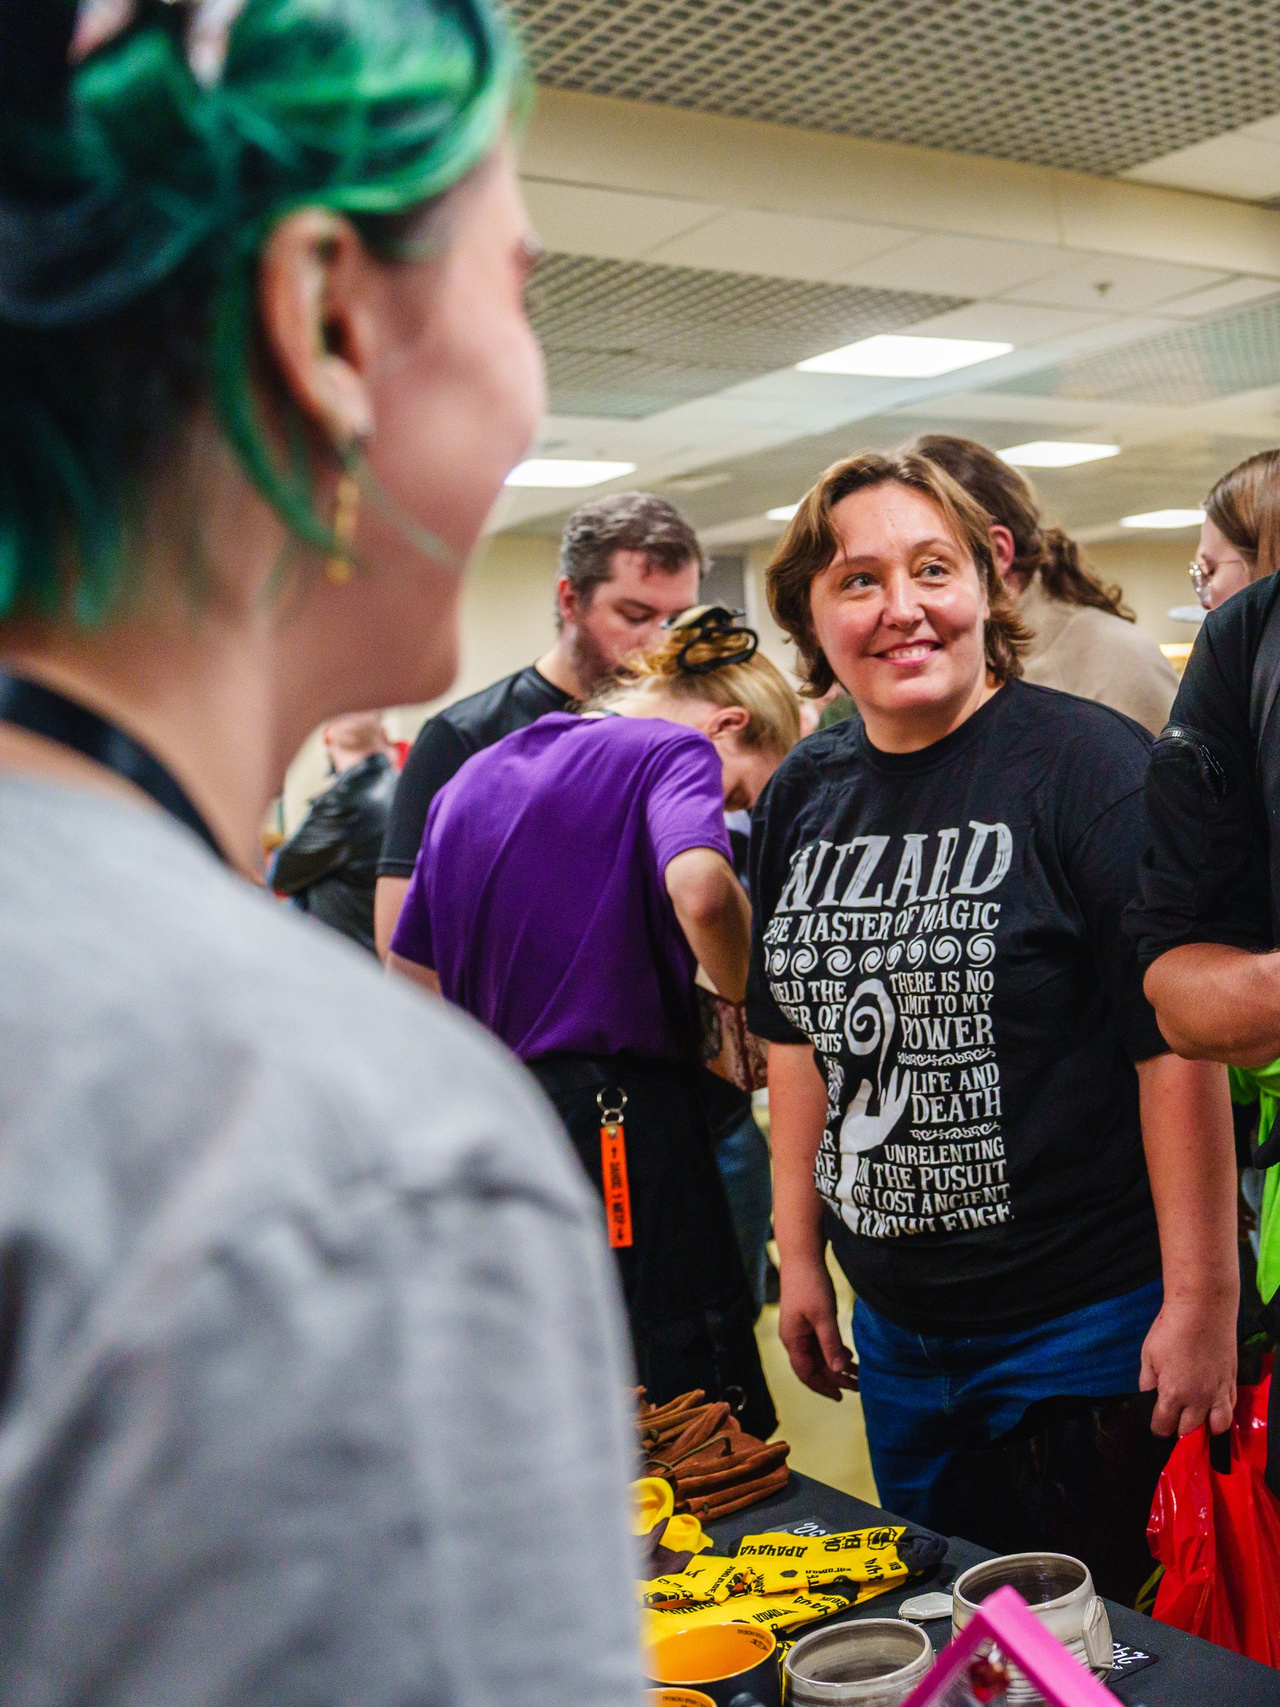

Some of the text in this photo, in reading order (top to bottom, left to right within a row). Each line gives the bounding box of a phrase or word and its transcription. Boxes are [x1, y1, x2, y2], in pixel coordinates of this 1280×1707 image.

[793, 911, 893, 943] MASTER
[893, 904, 920, 937] OF
[919, 900, 1001, 933] MAGIC
[807, 979, 848, 1004] THE
[889, 969, 995, 994] THERE IS NO
[818, 1004, 844, 1031] OF
[896, 992, 994, 1015] LIMIT TO MY
[899, 1013, 996, 1051] POWER
[911, 1062, 1000, 1095] LIFE AND
[910, 1086, 1002, 1125] DEATH
[884, 1136, 1005, 1166] UNRELENTING
[872, 1162, 917, 1190] THE
[918, 1158, 1007, 1192] PUSUIT
[852, 1185, 871, 1206] OF
[873, 1187, 916, 1214] LOST
[921, 1182, 1010, 1216] ANCIENT
